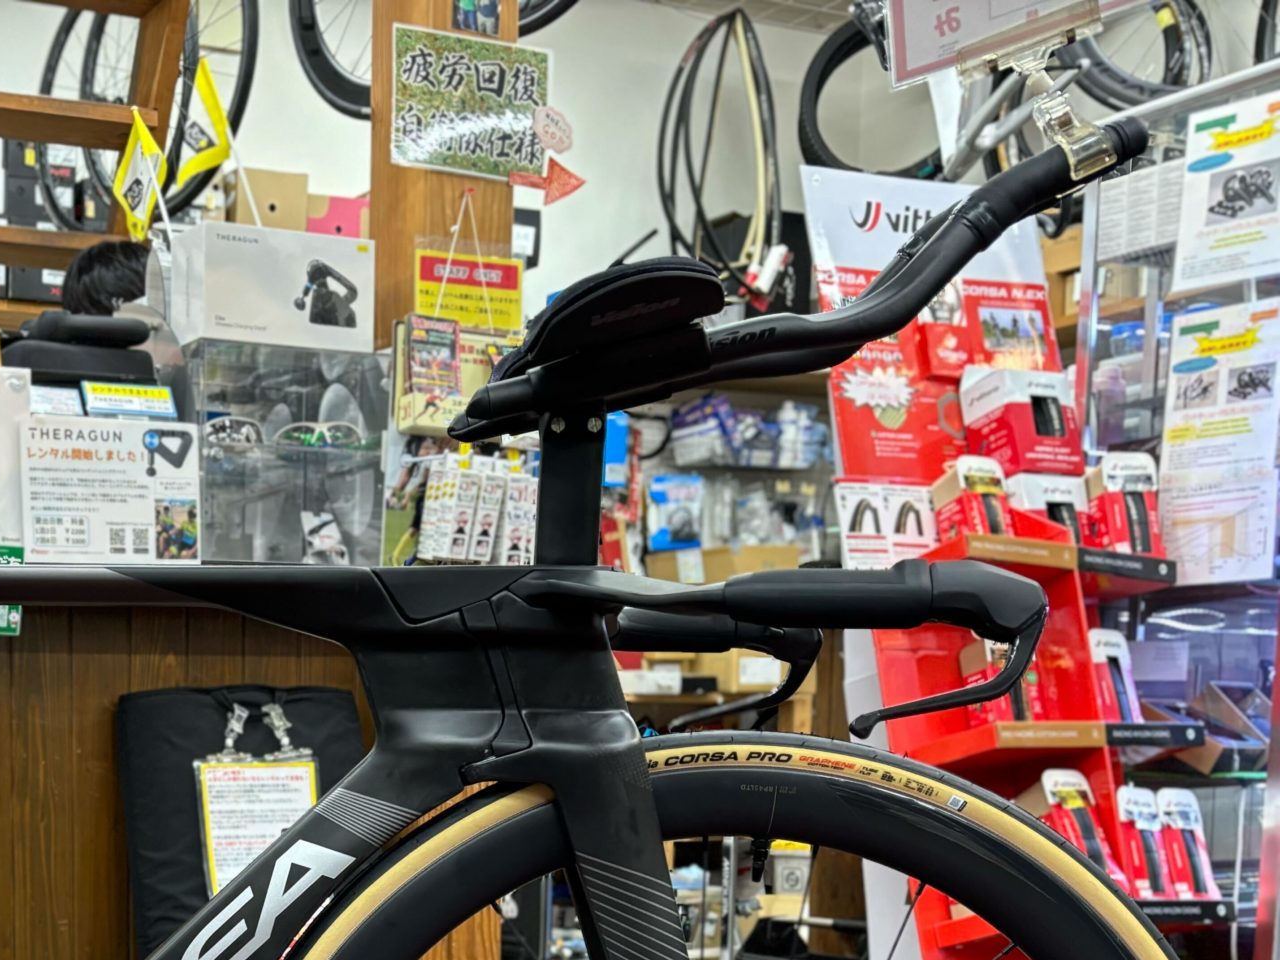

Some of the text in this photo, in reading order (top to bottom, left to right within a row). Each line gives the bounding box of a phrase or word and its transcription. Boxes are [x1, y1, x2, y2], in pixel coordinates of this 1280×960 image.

[402, 42, 540, 107] 疲労回復
[216, 233, 259, 244] THERAGUN
[710, 327, 776, 349] ision
[28, 428, 123, 443] THERAGUN
[27, 447, 144, 462] レンタル開始しました！
[664, 752, 738, 767] CORSA
[746, 751, 793, 763] PRO
[799, 755, 856, 769] GRAPHENE
